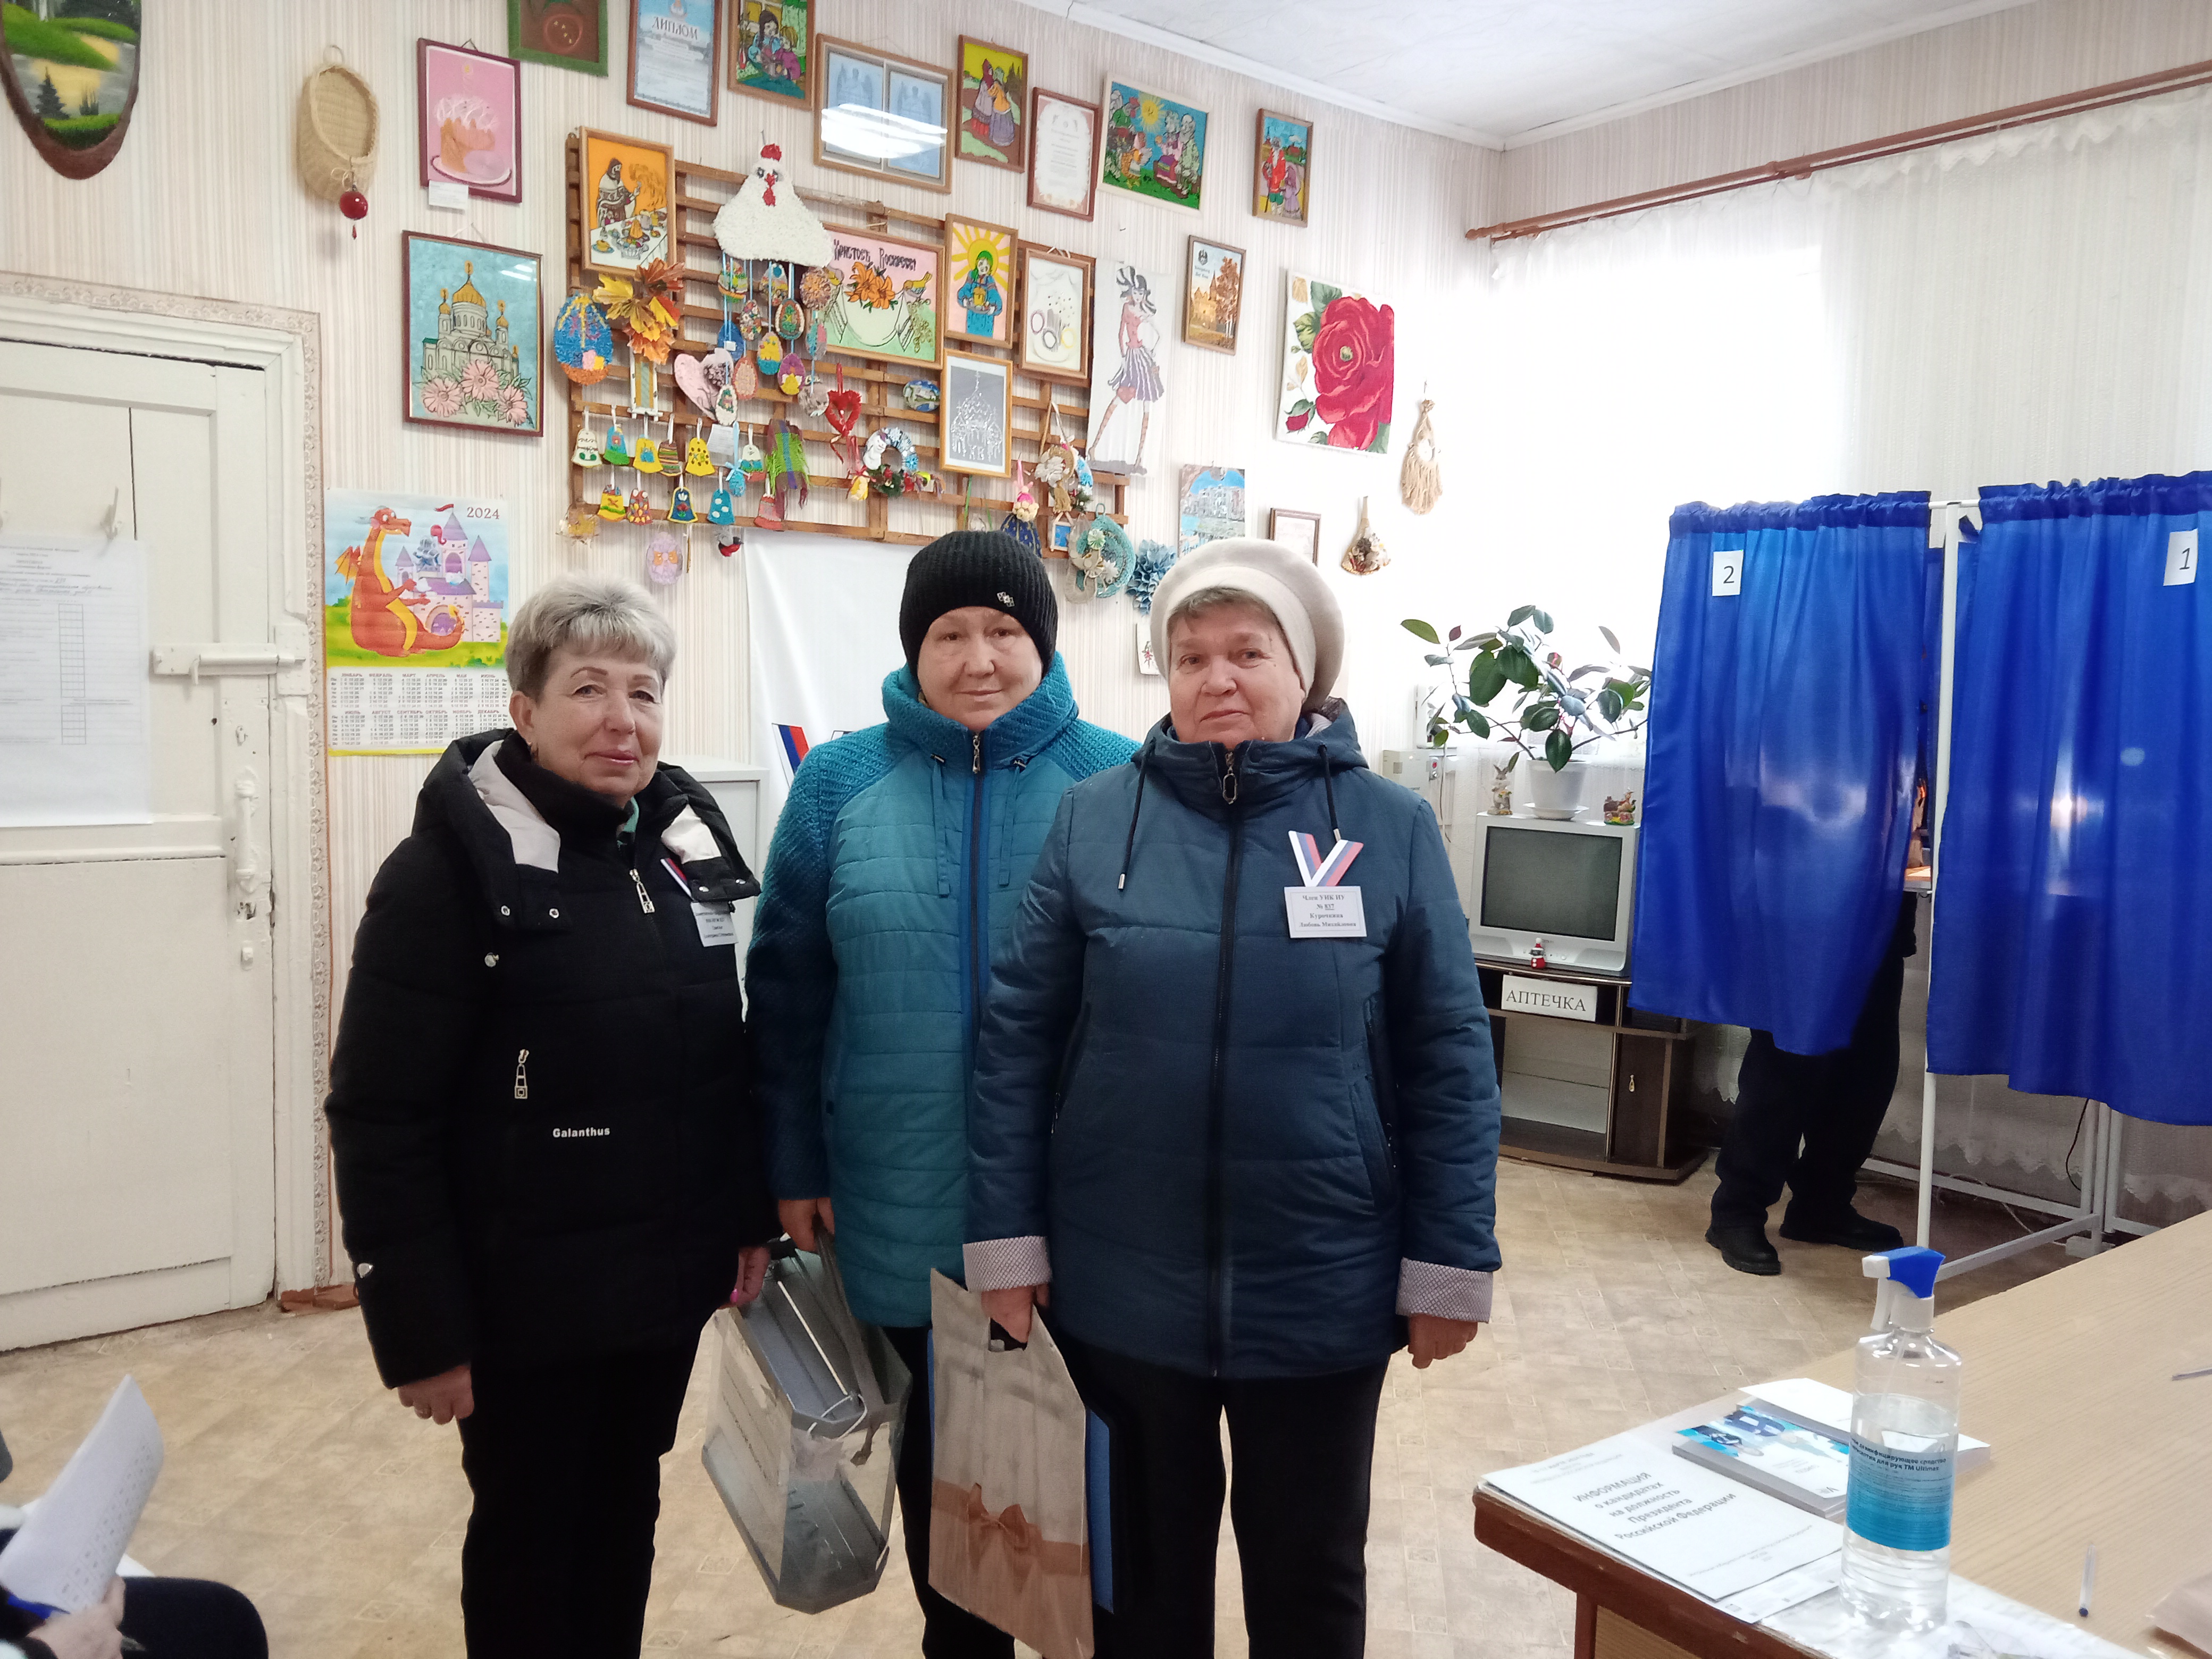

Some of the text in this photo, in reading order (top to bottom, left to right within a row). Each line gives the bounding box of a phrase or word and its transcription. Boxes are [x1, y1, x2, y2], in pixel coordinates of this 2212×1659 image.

[652, 16, 698, 40] ДИПЛОМ
[467, 507, 500, 520] 2024
[2179, 547, 2190, 570] 1
[1723, 565, 1735, 584] 2
[1506, 990, 1586, 1011] АПТЕЧКА
[552, 1127, 610, 1138] Galanthus
[1572, 1472, 1652, 1502] ИНФОРМАЦИЯ
[1603, 1481, 1664, 1506] кандидатах
[1624, 1489, 1680, 1512] должность
[1628, 1497, 1692, 1523] Президента
[1614, 1493, 1737, 1539] Российской Федерации
